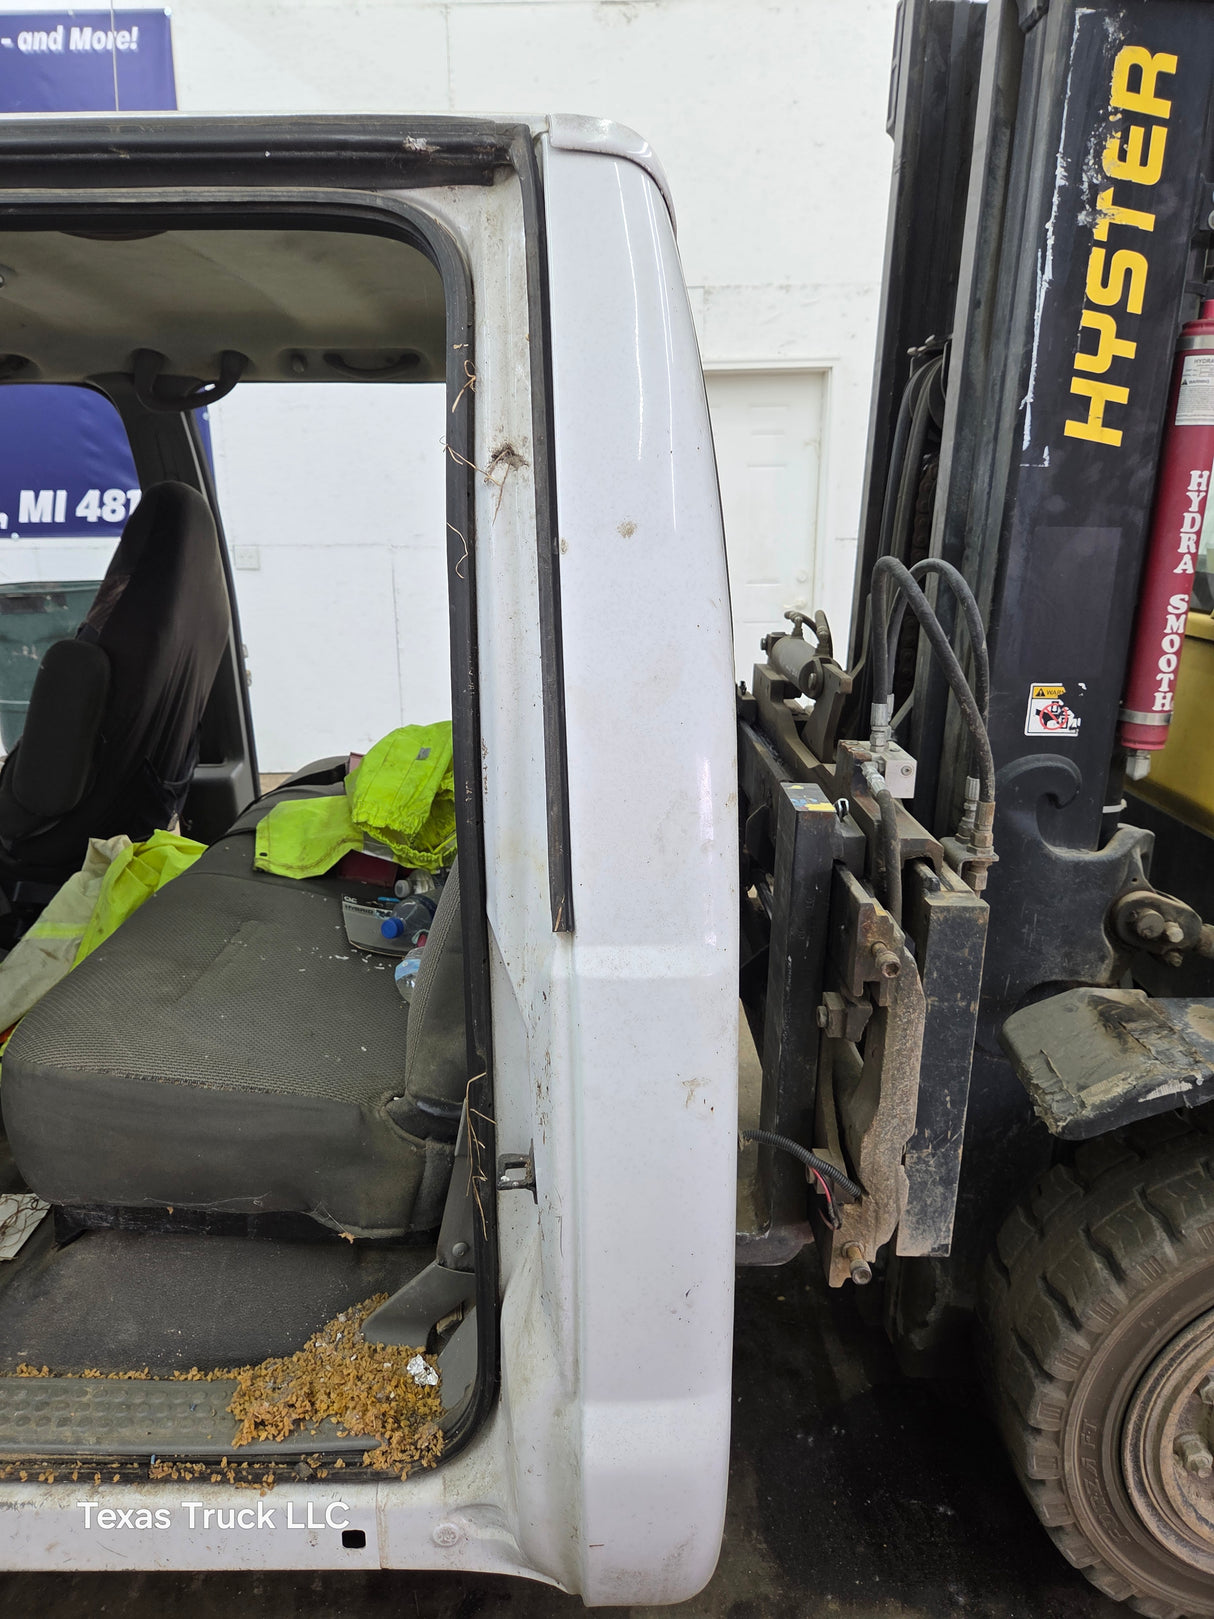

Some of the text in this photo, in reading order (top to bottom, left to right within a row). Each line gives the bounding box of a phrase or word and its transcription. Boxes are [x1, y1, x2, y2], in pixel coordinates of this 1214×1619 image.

[17, 24, 63, 51] and
[69, 26, 138, 51] More!
[1064, 45, 1178, 447] HYSTER
[19, 490, 67, 523] MI
[1152, 470, 1210, 711] HYDRA SMOOTH
